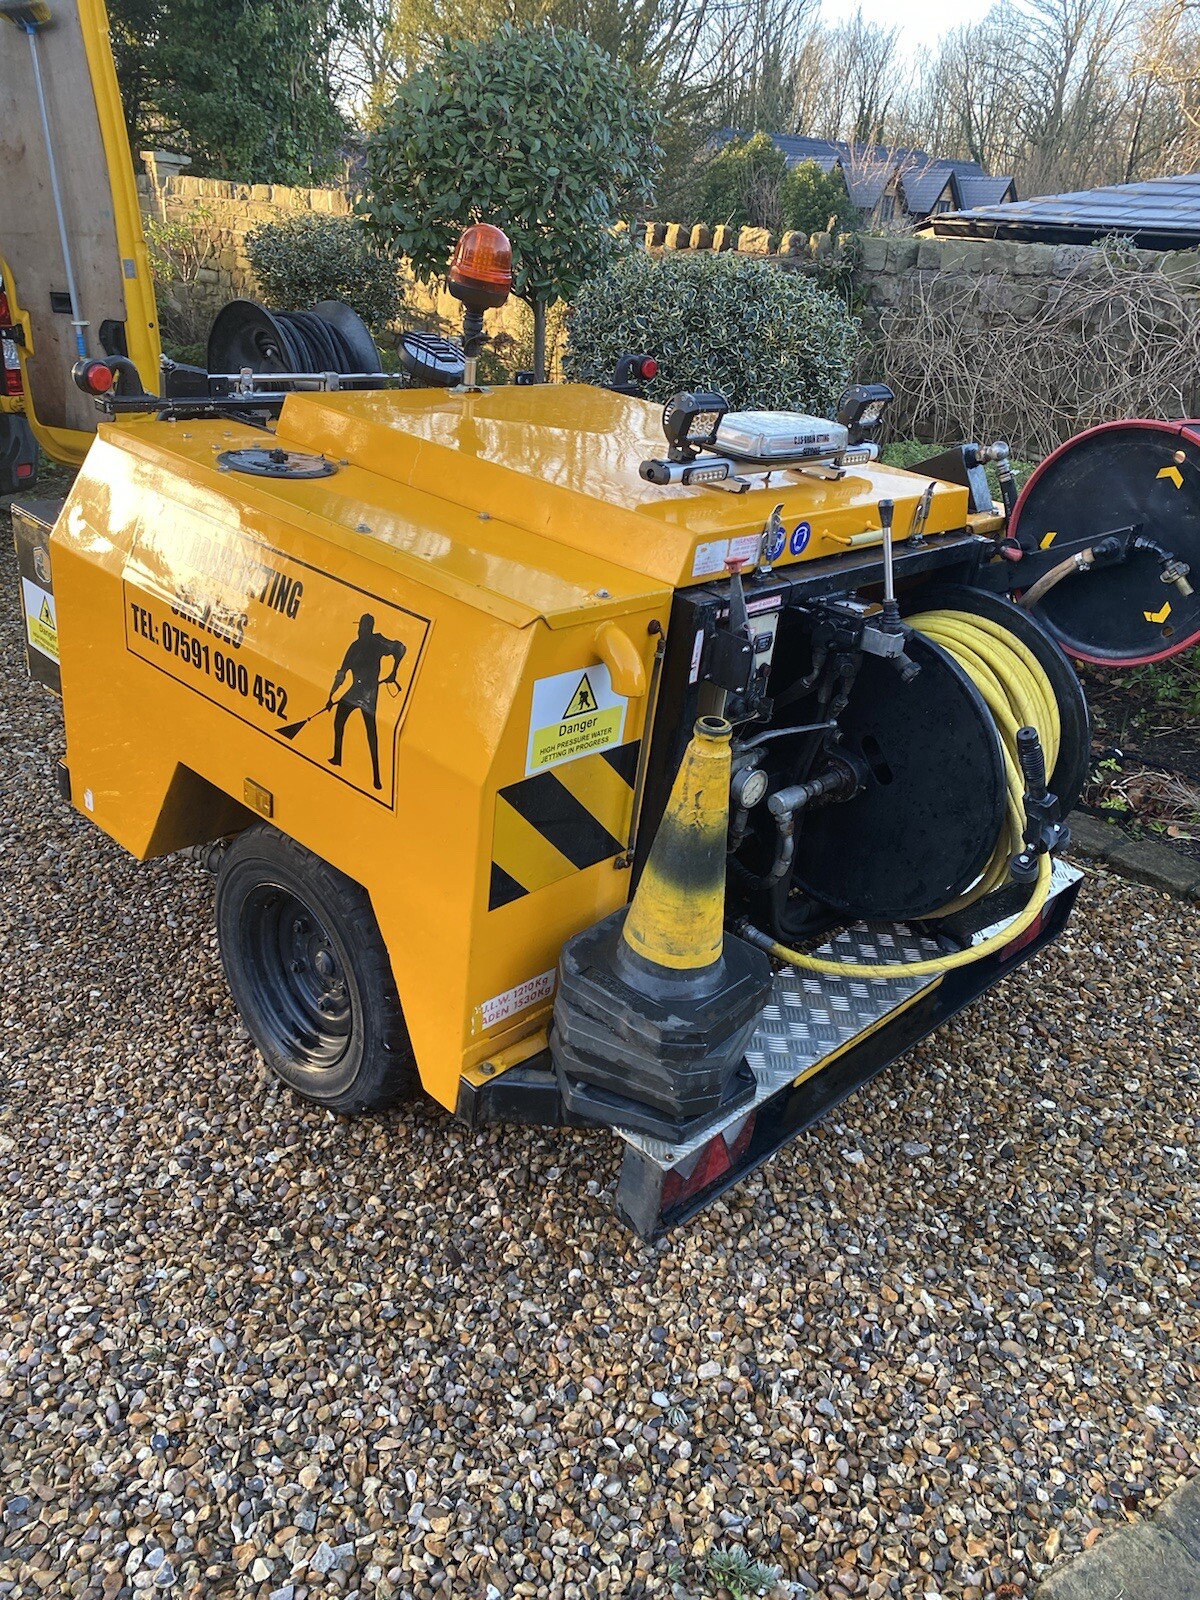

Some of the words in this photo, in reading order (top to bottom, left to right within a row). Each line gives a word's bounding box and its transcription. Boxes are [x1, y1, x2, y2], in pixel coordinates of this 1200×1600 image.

[130, 602, 159, 645] TEL:
[162, 621, 210, 675] 07591
[214, 651, 249, 697] 900
[252, 673, 288, 721] 452
[558, 717, 598, 737] Danger
[539, 744, 556, 756] HIGH
[556, 733, 590, 749] PRESSURE
[591, 727, 613, 738] WATER
[540, 750, 568, 764] JETTING
[567, 747, 574, 755] IN
[575, 736, 610, 752] PROGRESS
